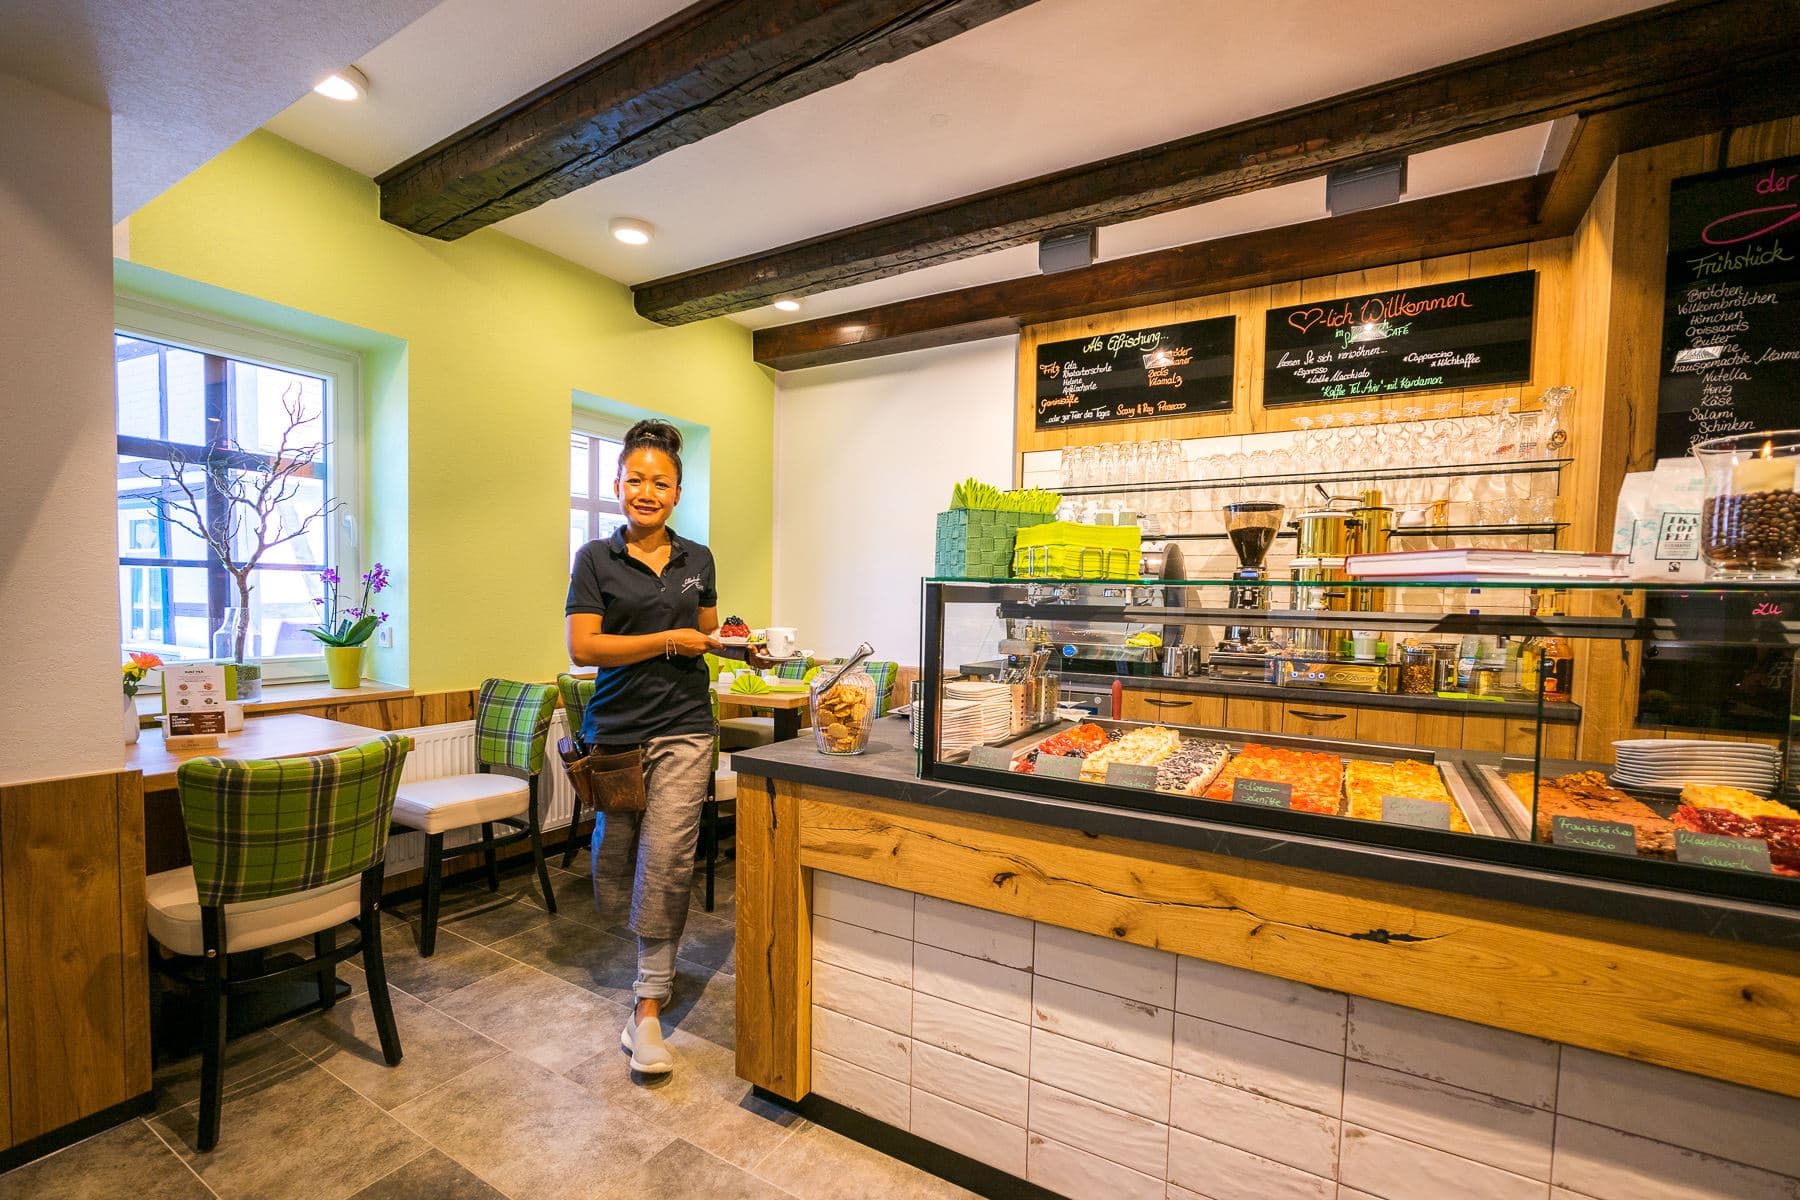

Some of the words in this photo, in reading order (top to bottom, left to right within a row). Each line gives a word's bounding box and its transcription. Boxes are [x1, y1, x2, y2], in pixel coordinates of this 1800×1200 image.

[1756, 168, 1798, 193] der
[1686, 239, 1795, 278] Frühstück
[1687, 282, 1744, 302] Brötchen
[1361, 292, 1473, 323] Willkommen
[1678, 291, 1779, 315] Vollkornbrötchen
[1690, 310, 1745, 325] Hörnchen
[1685, 319, 1750, 337] Croissants
[1083, 336, 1103, 354] Als
[1690, 334, 1737, 348] Butter
[1064, 360, 1078, 370] Cola
[1317, 351, 1333, 363] sich
[1040, 361, 1060, 379] Fritz
[1702, 367, 1752, 383] Nutella
[1702, 383, 1733, 397] Honig
[1700, 394, 1735, 407] Käse
[1091, 405, 1111, 420] Tages
[1688, 407, 1735, 422] Salami
[1698, 417, 1756, 434] Schinken
